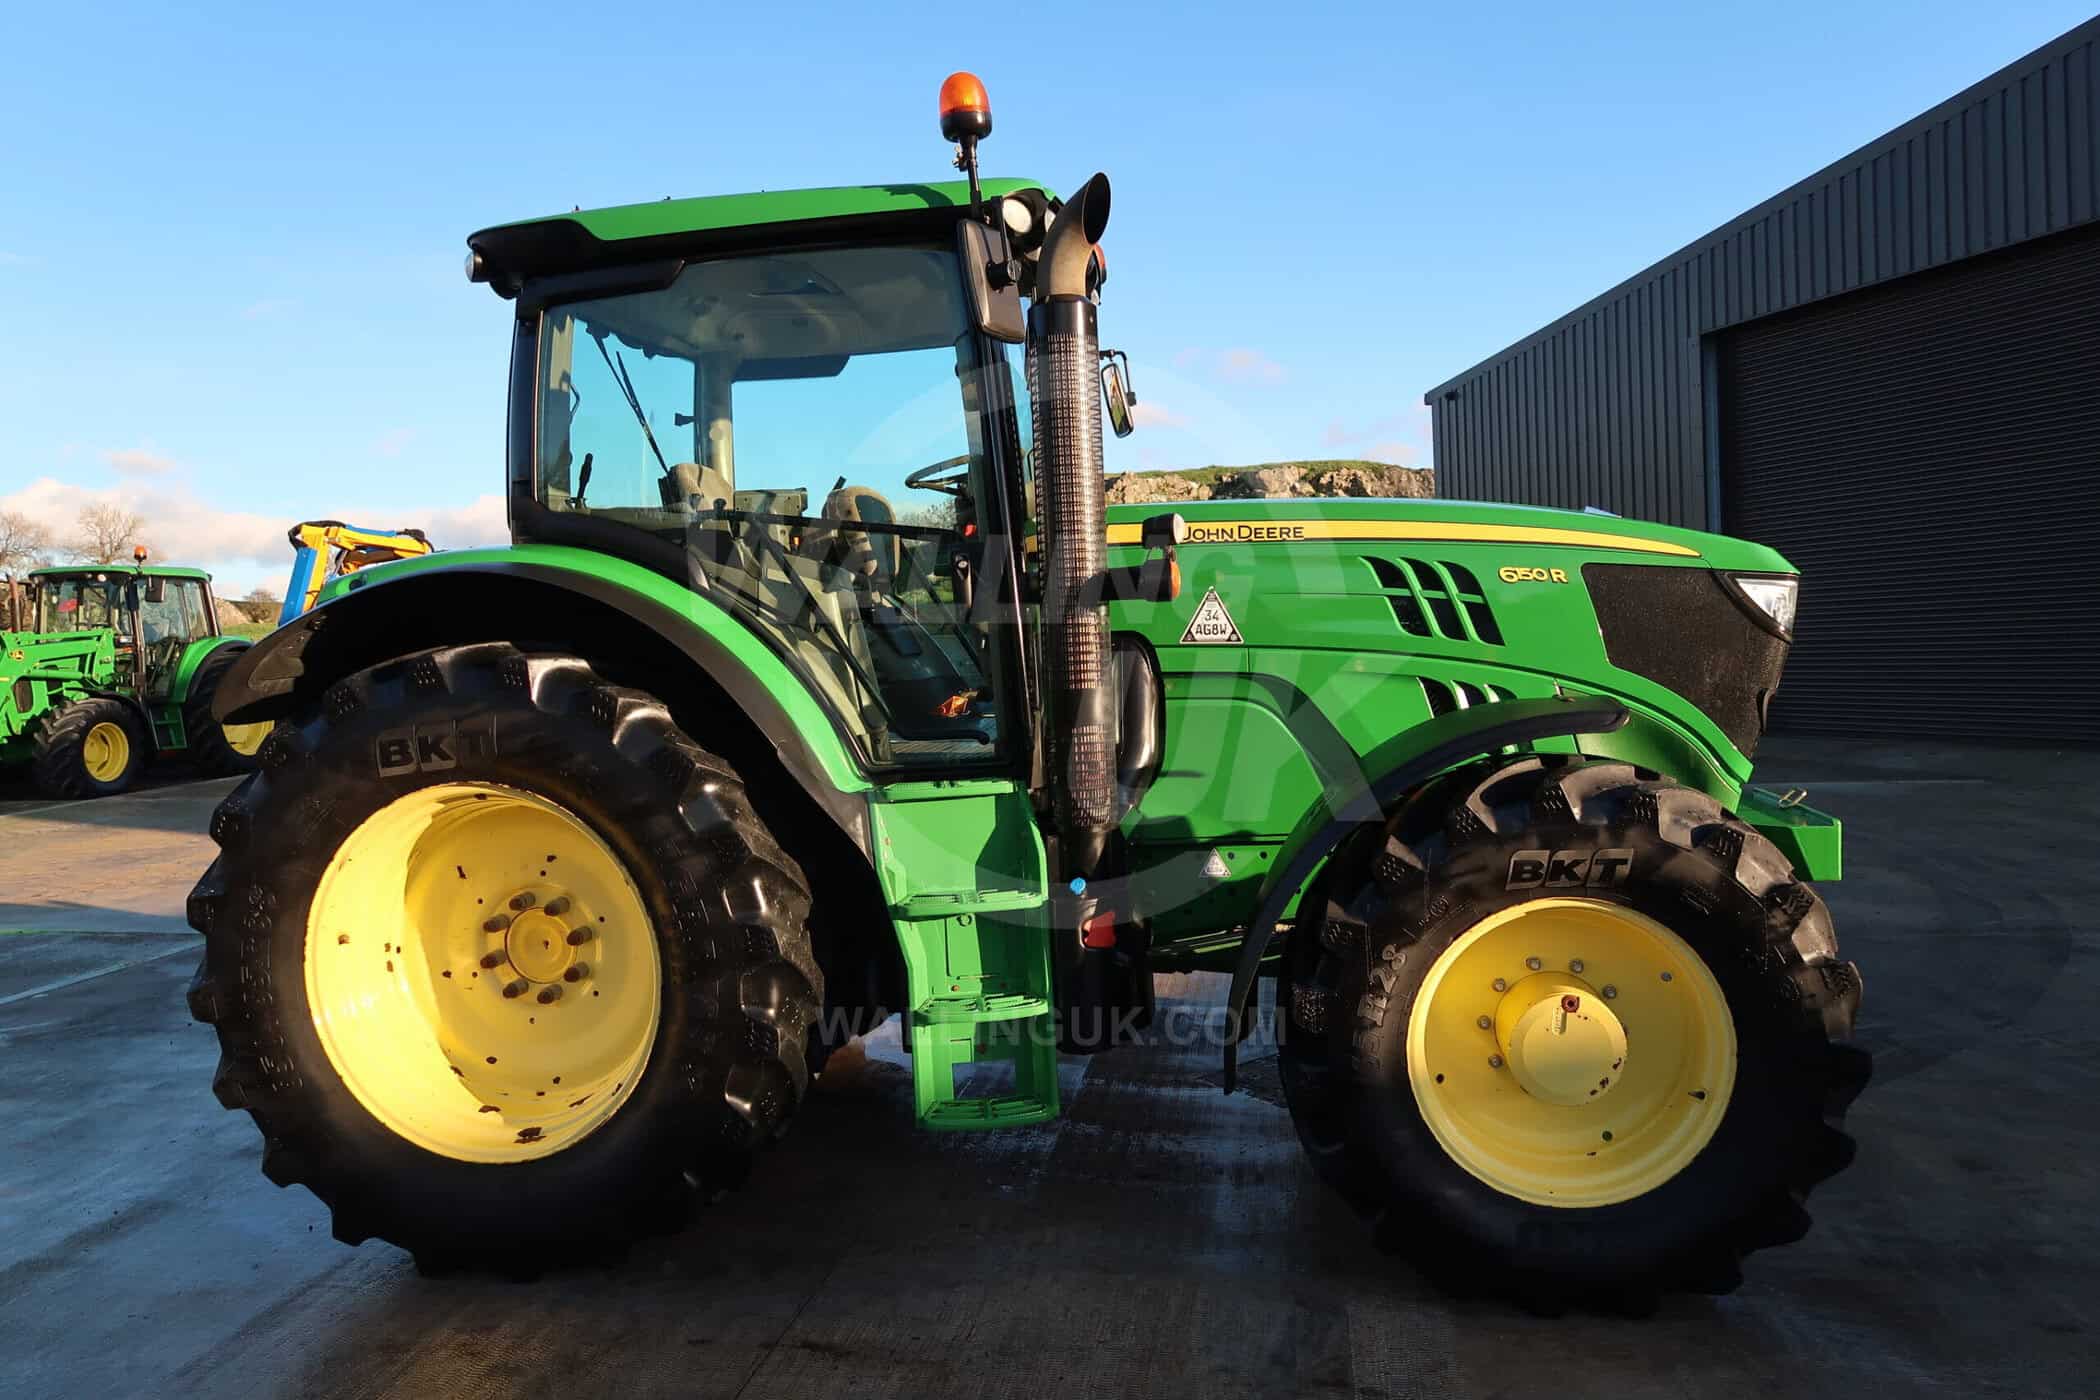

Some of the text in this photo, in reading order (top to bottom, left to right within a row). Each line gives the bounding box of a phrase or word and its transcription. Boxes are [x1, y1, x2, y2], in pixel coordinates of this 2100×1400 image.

[1183, 525, 1305, 541] JOHN DEERE
[1204, 609, 1219, 621] 34
[1195, 623, 1227, 636] AG8W
[380, 722, 496, 772] BKT
[1508, 853, 1631, 886] BKT
